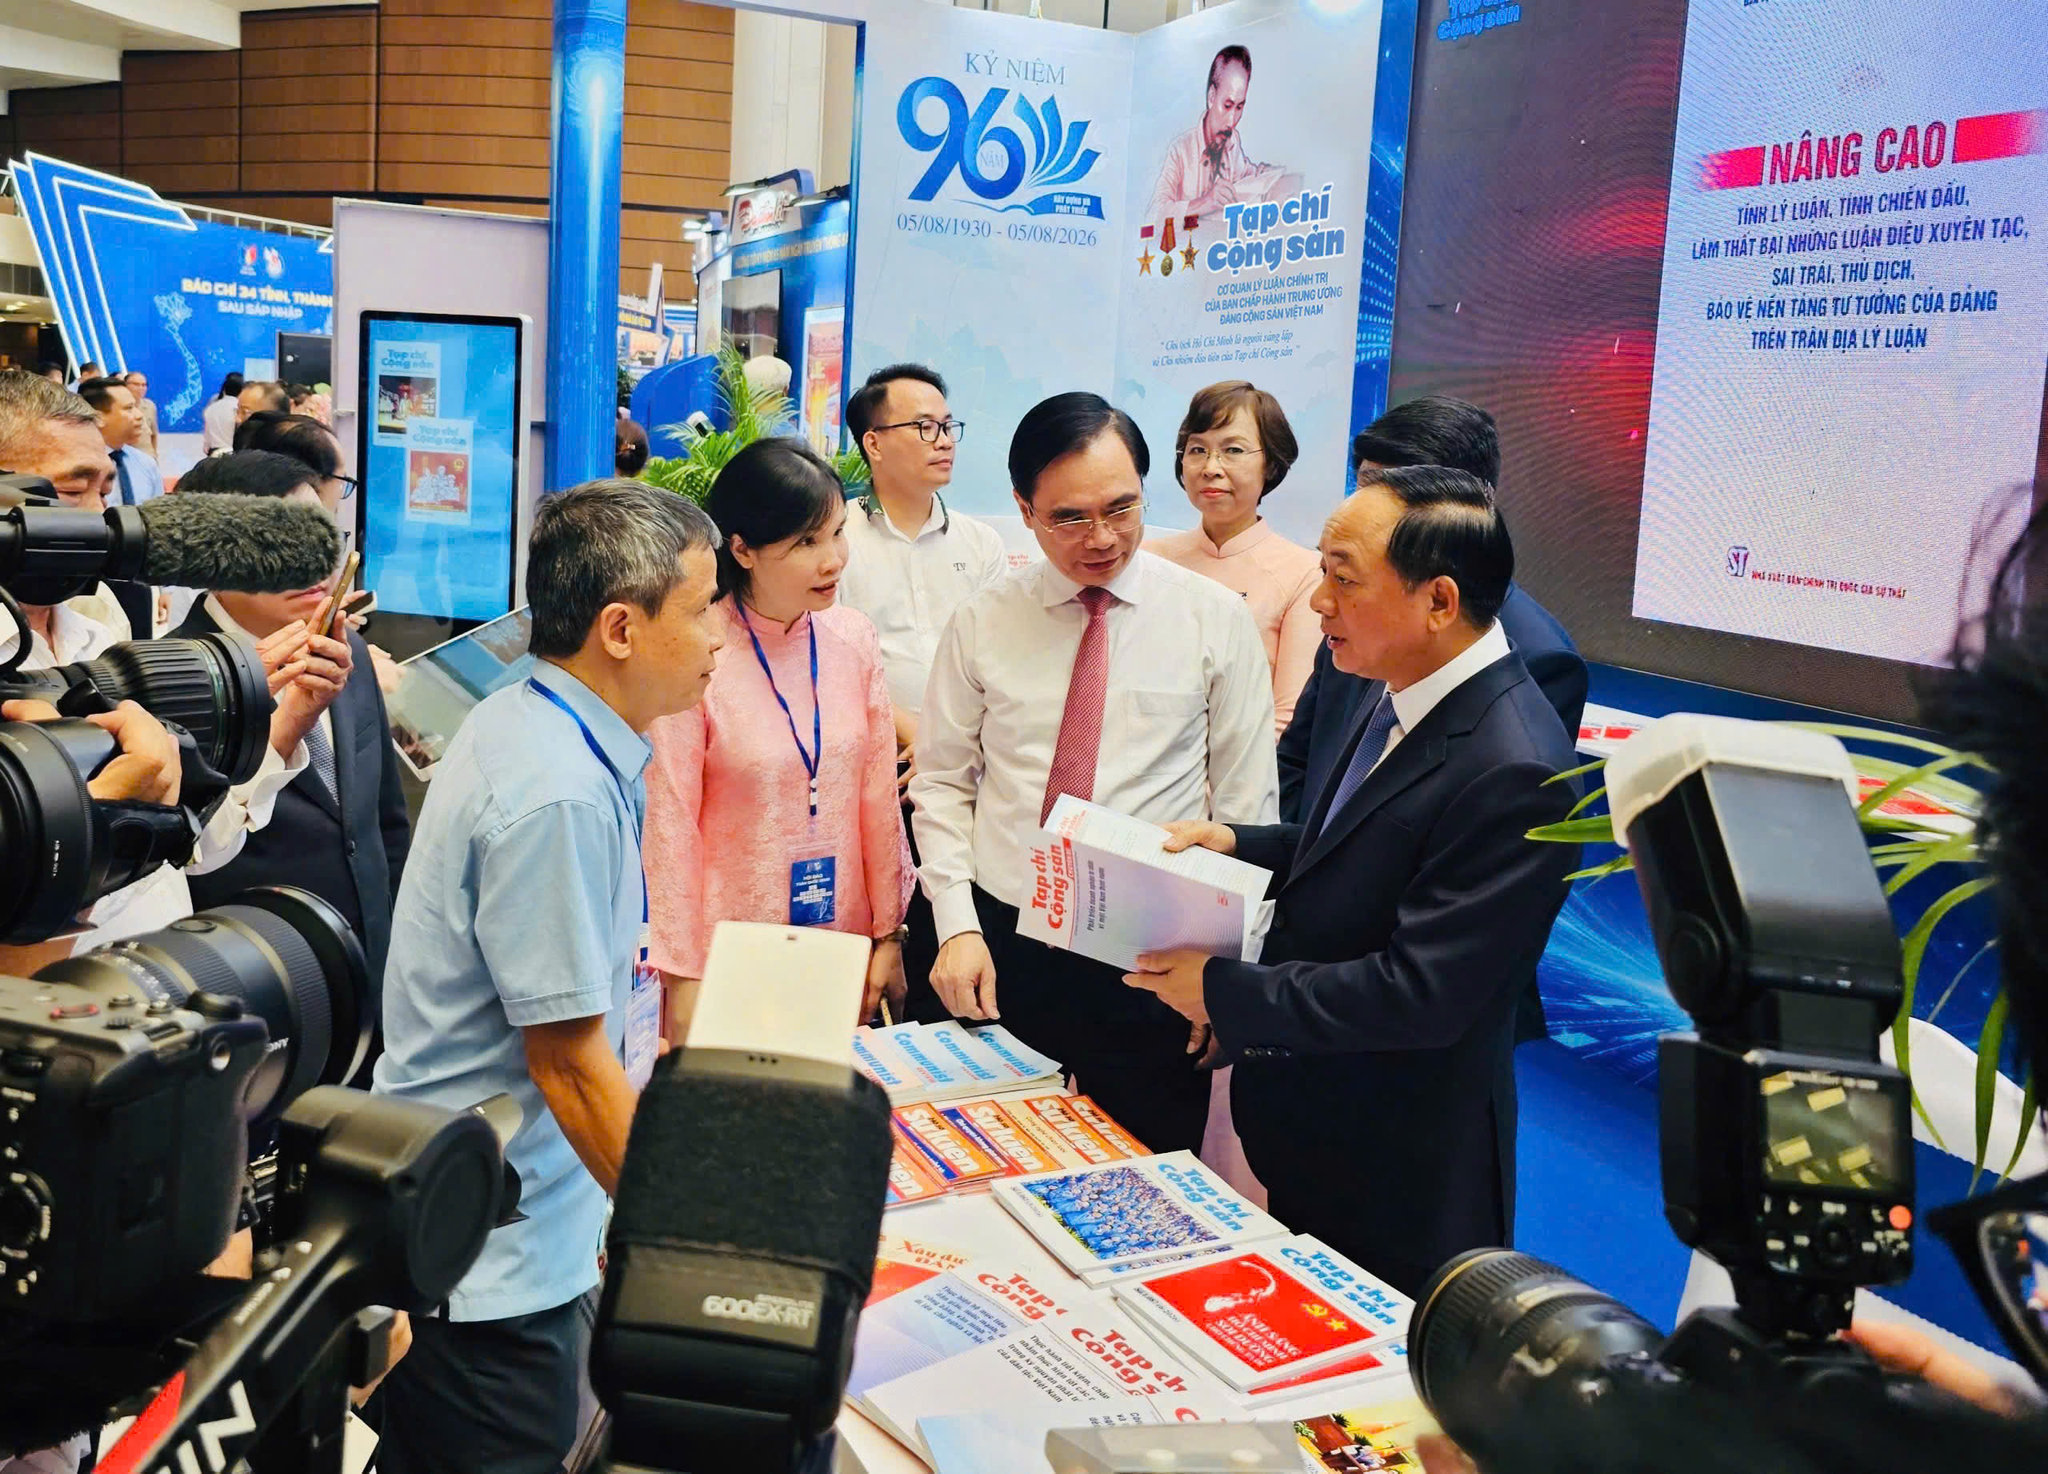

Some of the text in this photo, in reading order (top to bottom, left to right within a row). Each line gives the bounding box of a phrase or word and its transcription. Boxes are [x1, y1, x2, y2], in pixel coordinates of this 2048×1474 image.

[965, 50, 1066, 86] KỶ NIỆM
[896, 76, 1027, 201] 96
[980, 150, 1005, 169] NĂM
[1769, 121, 1947, 185] NÂNG CAO
[1224, 182, 1334, 240] Tạp chí
[1737, 203, 1768, 225] TÍNH
[1771, 199, 1788, 223] LÝ
[1878, 184, 1927, 213] CHIẾN
[897, 213, 1098, 247] 05/08/1930 05/08/2026
[1206, 223, 1346, 276] Cộng sản
[1692, 238, 1720, 260] LÀM
[1759, 236, 1783, 259] BẠI
[1928, 215, 1986, 243] XUYÊN
[1992, 216, 2028, 243] TẠC,
[181, 277, 213, 294] BÁO
[213, 281, 237, 298] CHÍ
[238, 285, 257, 299] 34
[1204, 286, 1343, 312] CỦA BAN CHẤP HÀNH TRUNG ƯƠNG
[1217, 272, 1329, 296] CƠ QUAN LÝ LUẬN CHÍNH TRỊ
[1772, 267, 1795, 286] SAI
[217, 299, 244, 314] SAU
[245, 302, 270, 317] SÁP
[1219, 304, 1324, 325] ĐẢNG CỘNG SẢN VIỆT NAM
[1833, 294, 1853, 316] TƯ
[1855, 288, 1906, 315] TƯỞNG
[1912, 286, 1945, 313] CỦA
[1950, 284, 1998, 312] ĐẢNG
[1791, 326, 1828, 353] TRẬN
[1863, 324, 1881, 348] LÝ
[1885, 323, 1927, 353] LUẬN
[1029, 846, 1051, 910] Tạp chí
[1047, 843, 1069, 930] Cộng sản
[894, 1032, 954, 1084] Communist
[934, 1030, 998, 1081] Communist
[977, 1031, 1042, 1077] Communist
[1157, 1163, 1244, 1231] Cộng sản
[1182, 1168, 1254, 1220] Tạp chí
[977, 1273, 1046, 1321] Cộng
[1011, 1273, 1056, 1308] Tạp
[1280, 1247, 1396, 1326] Cộng sản
[1308, 1251, 1401, 1309] Tạp chí
[1070, 1328, 1142, 1385] Cộng
[1103, 1329, 1153, 1371] Tạp
